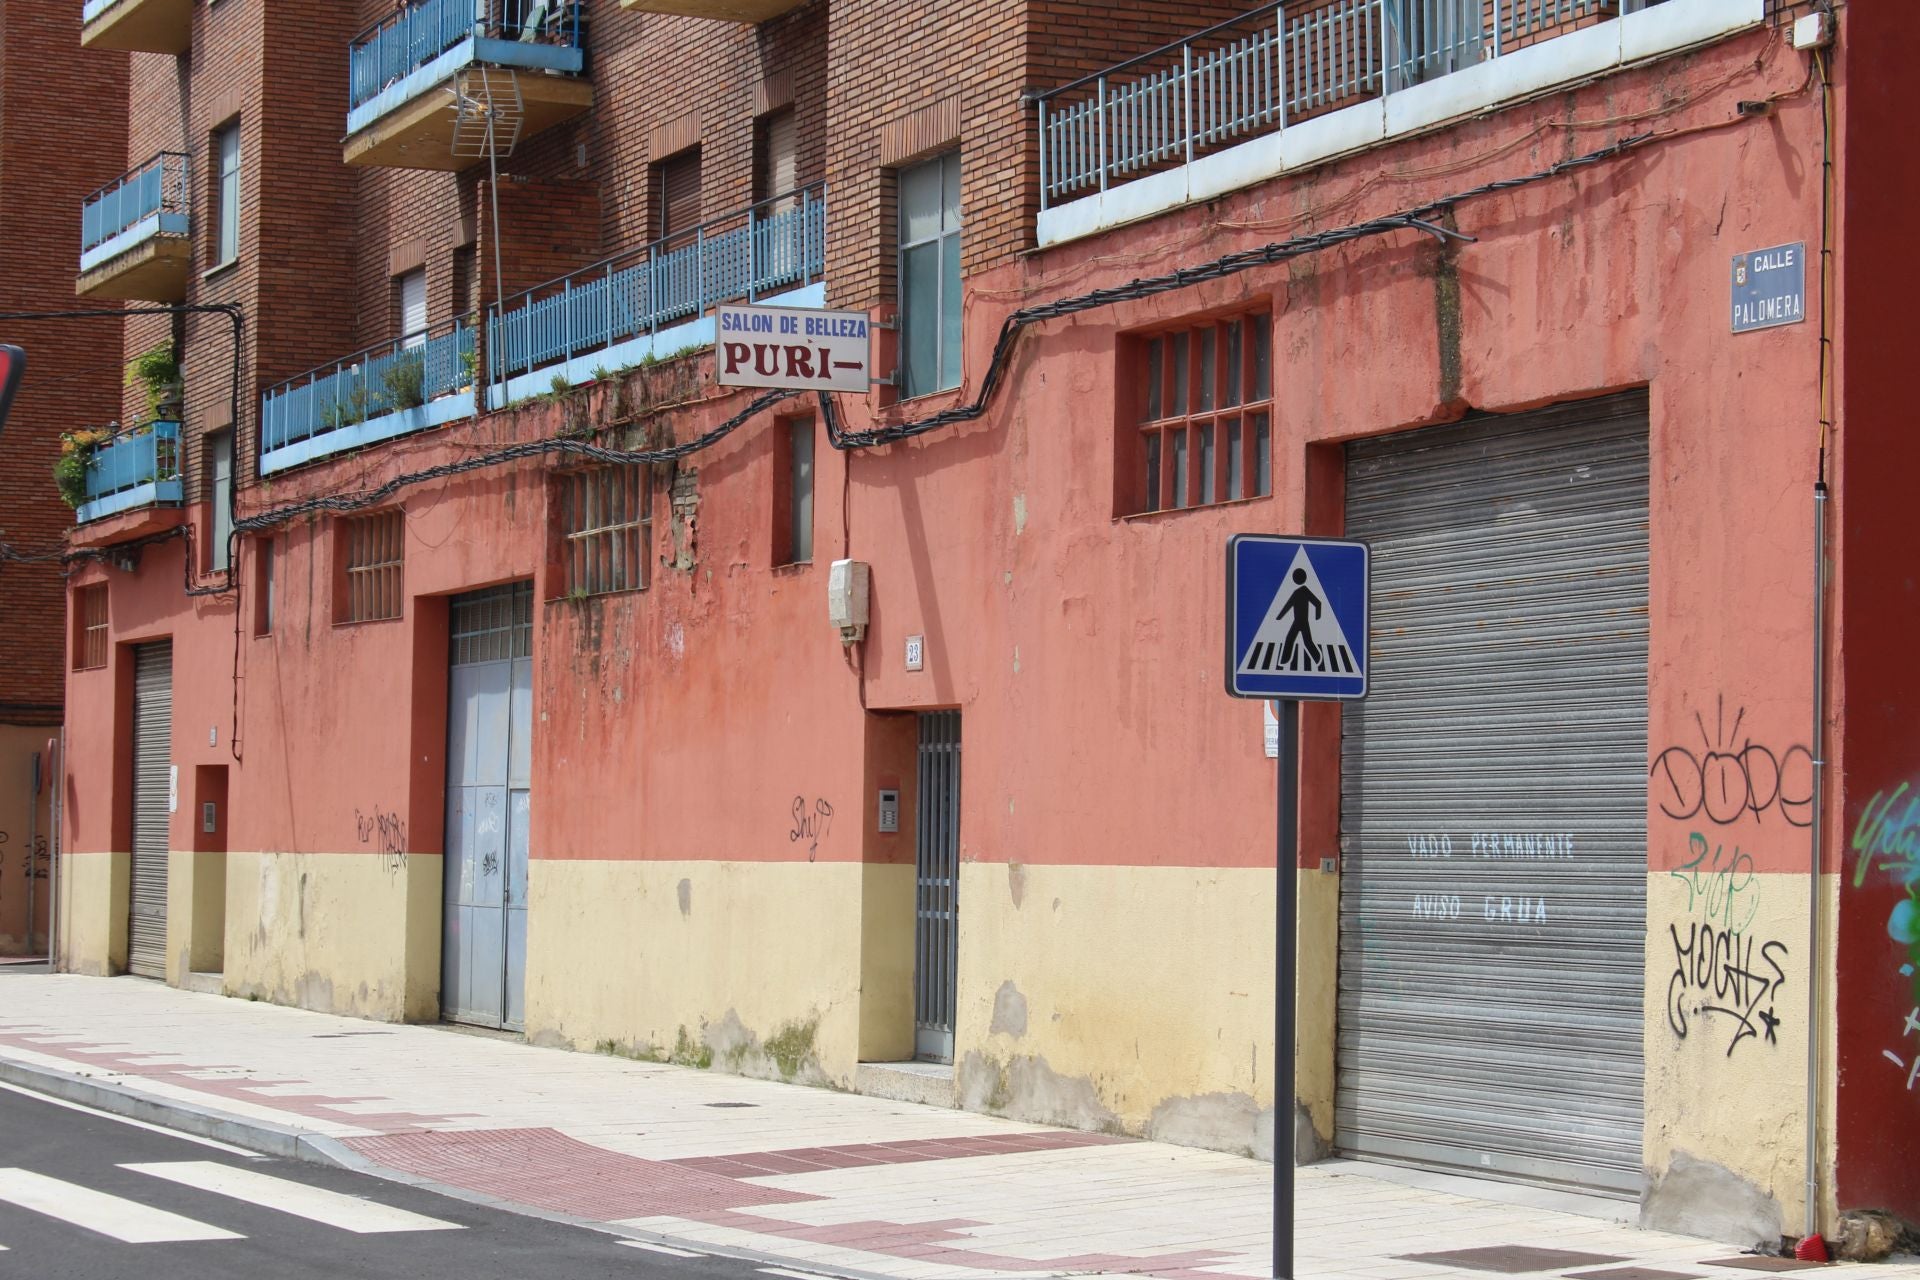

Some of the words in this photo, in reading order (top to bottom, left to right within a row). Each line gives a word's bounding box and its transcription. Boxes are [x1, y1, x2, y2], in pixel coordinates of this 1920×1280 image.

[1754, 249, 1794, 273] CALLE
[1734, 293, 1800, 326] PALOMERA
[721, 312, 773, 333] SALON
[779, 315, 799, 335] DE
[805, 317, 867, 339] BELLEZA
[723, 341, 832, 380] PURI
[909, 643, 919, 662] 23
[1407, 833, 1453, 858] VADO
[1471, 833, 1574, 859] PERMANENTE
[1412, 894, 1461, 921] AVISO
[1484, 895, 1547, 925] GRUA
